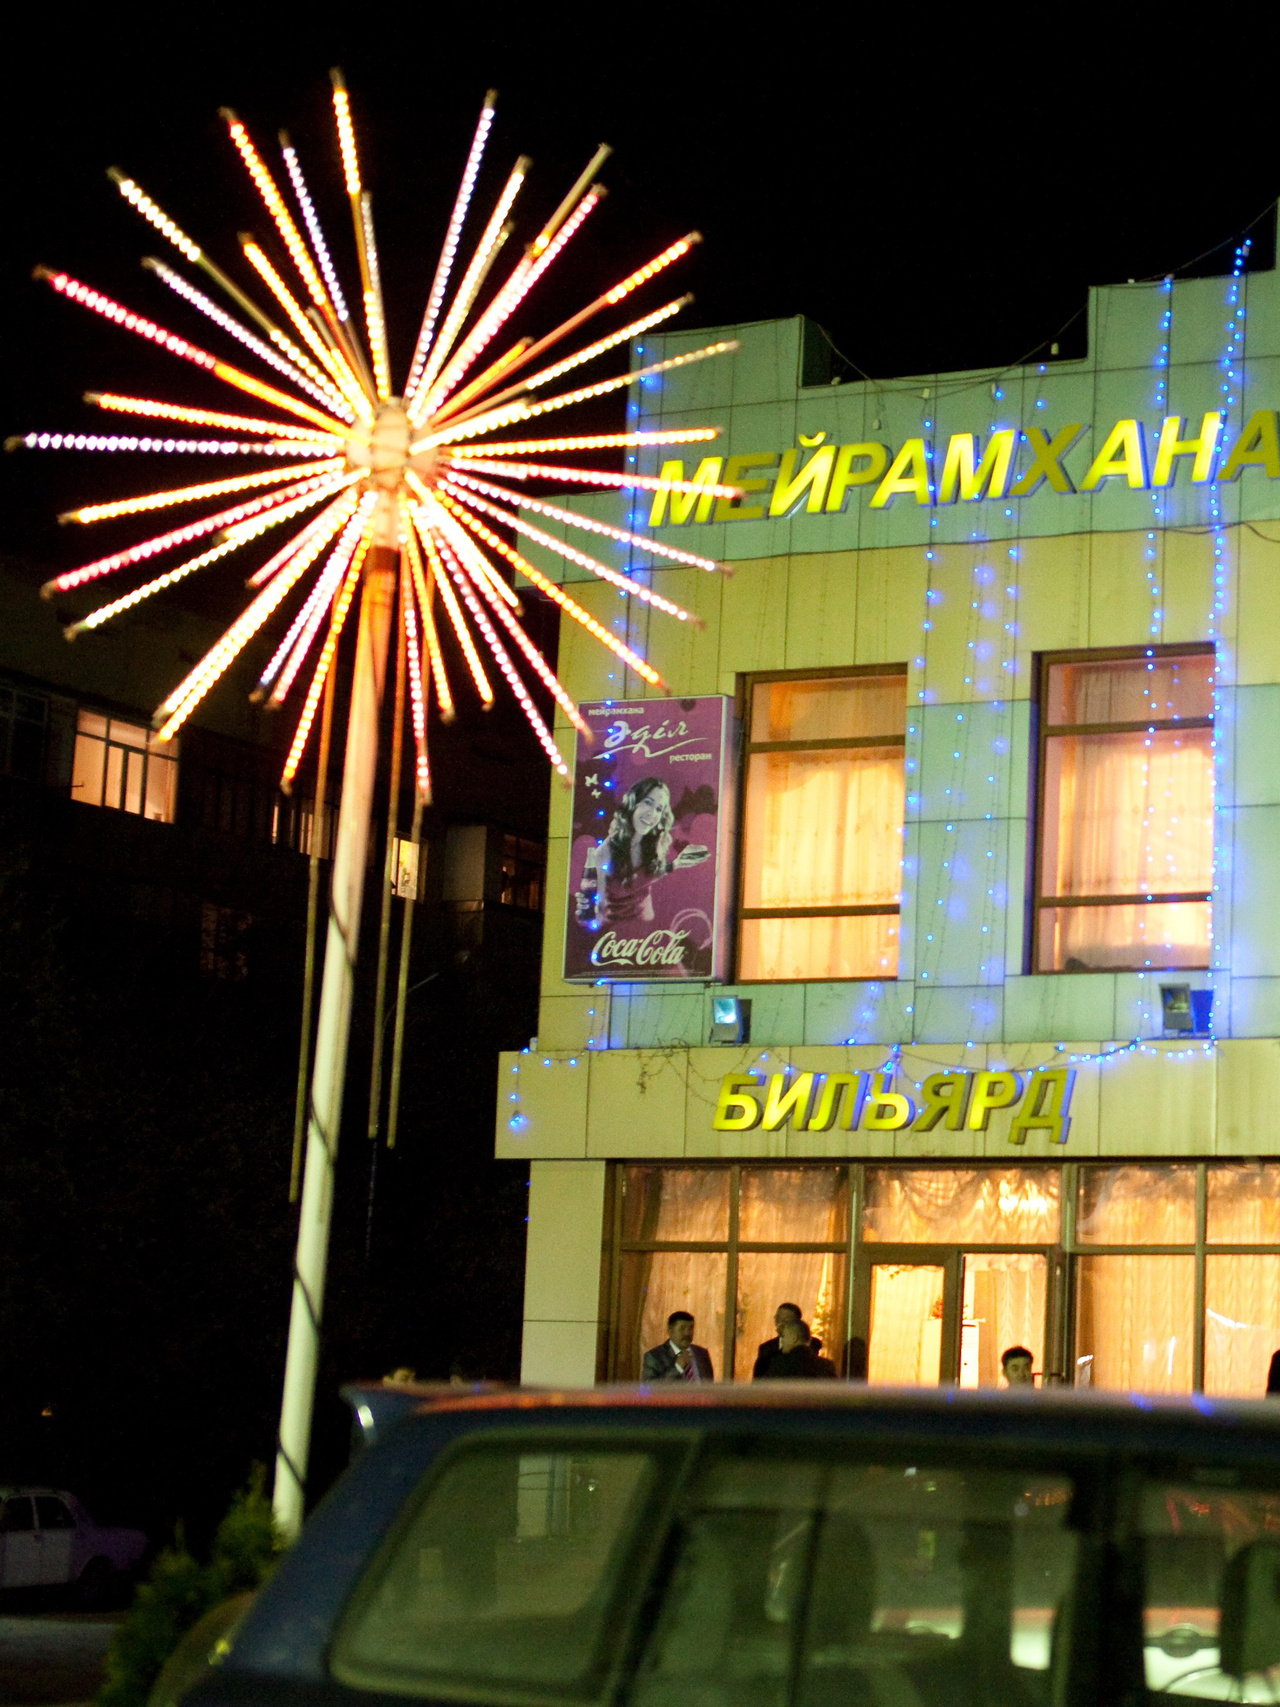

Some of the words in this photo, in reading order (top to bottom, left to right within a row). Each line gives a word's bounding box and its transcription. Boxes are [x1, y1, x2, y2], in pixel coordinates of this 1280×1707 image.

[588, 706, 645, 717] мейрамхана
[669, 753, 713, 764] ресторан
[590, 929, 692, 967] Coca-Cola
[712, 1070, 1075, 1145] БИЛЬЯРД
